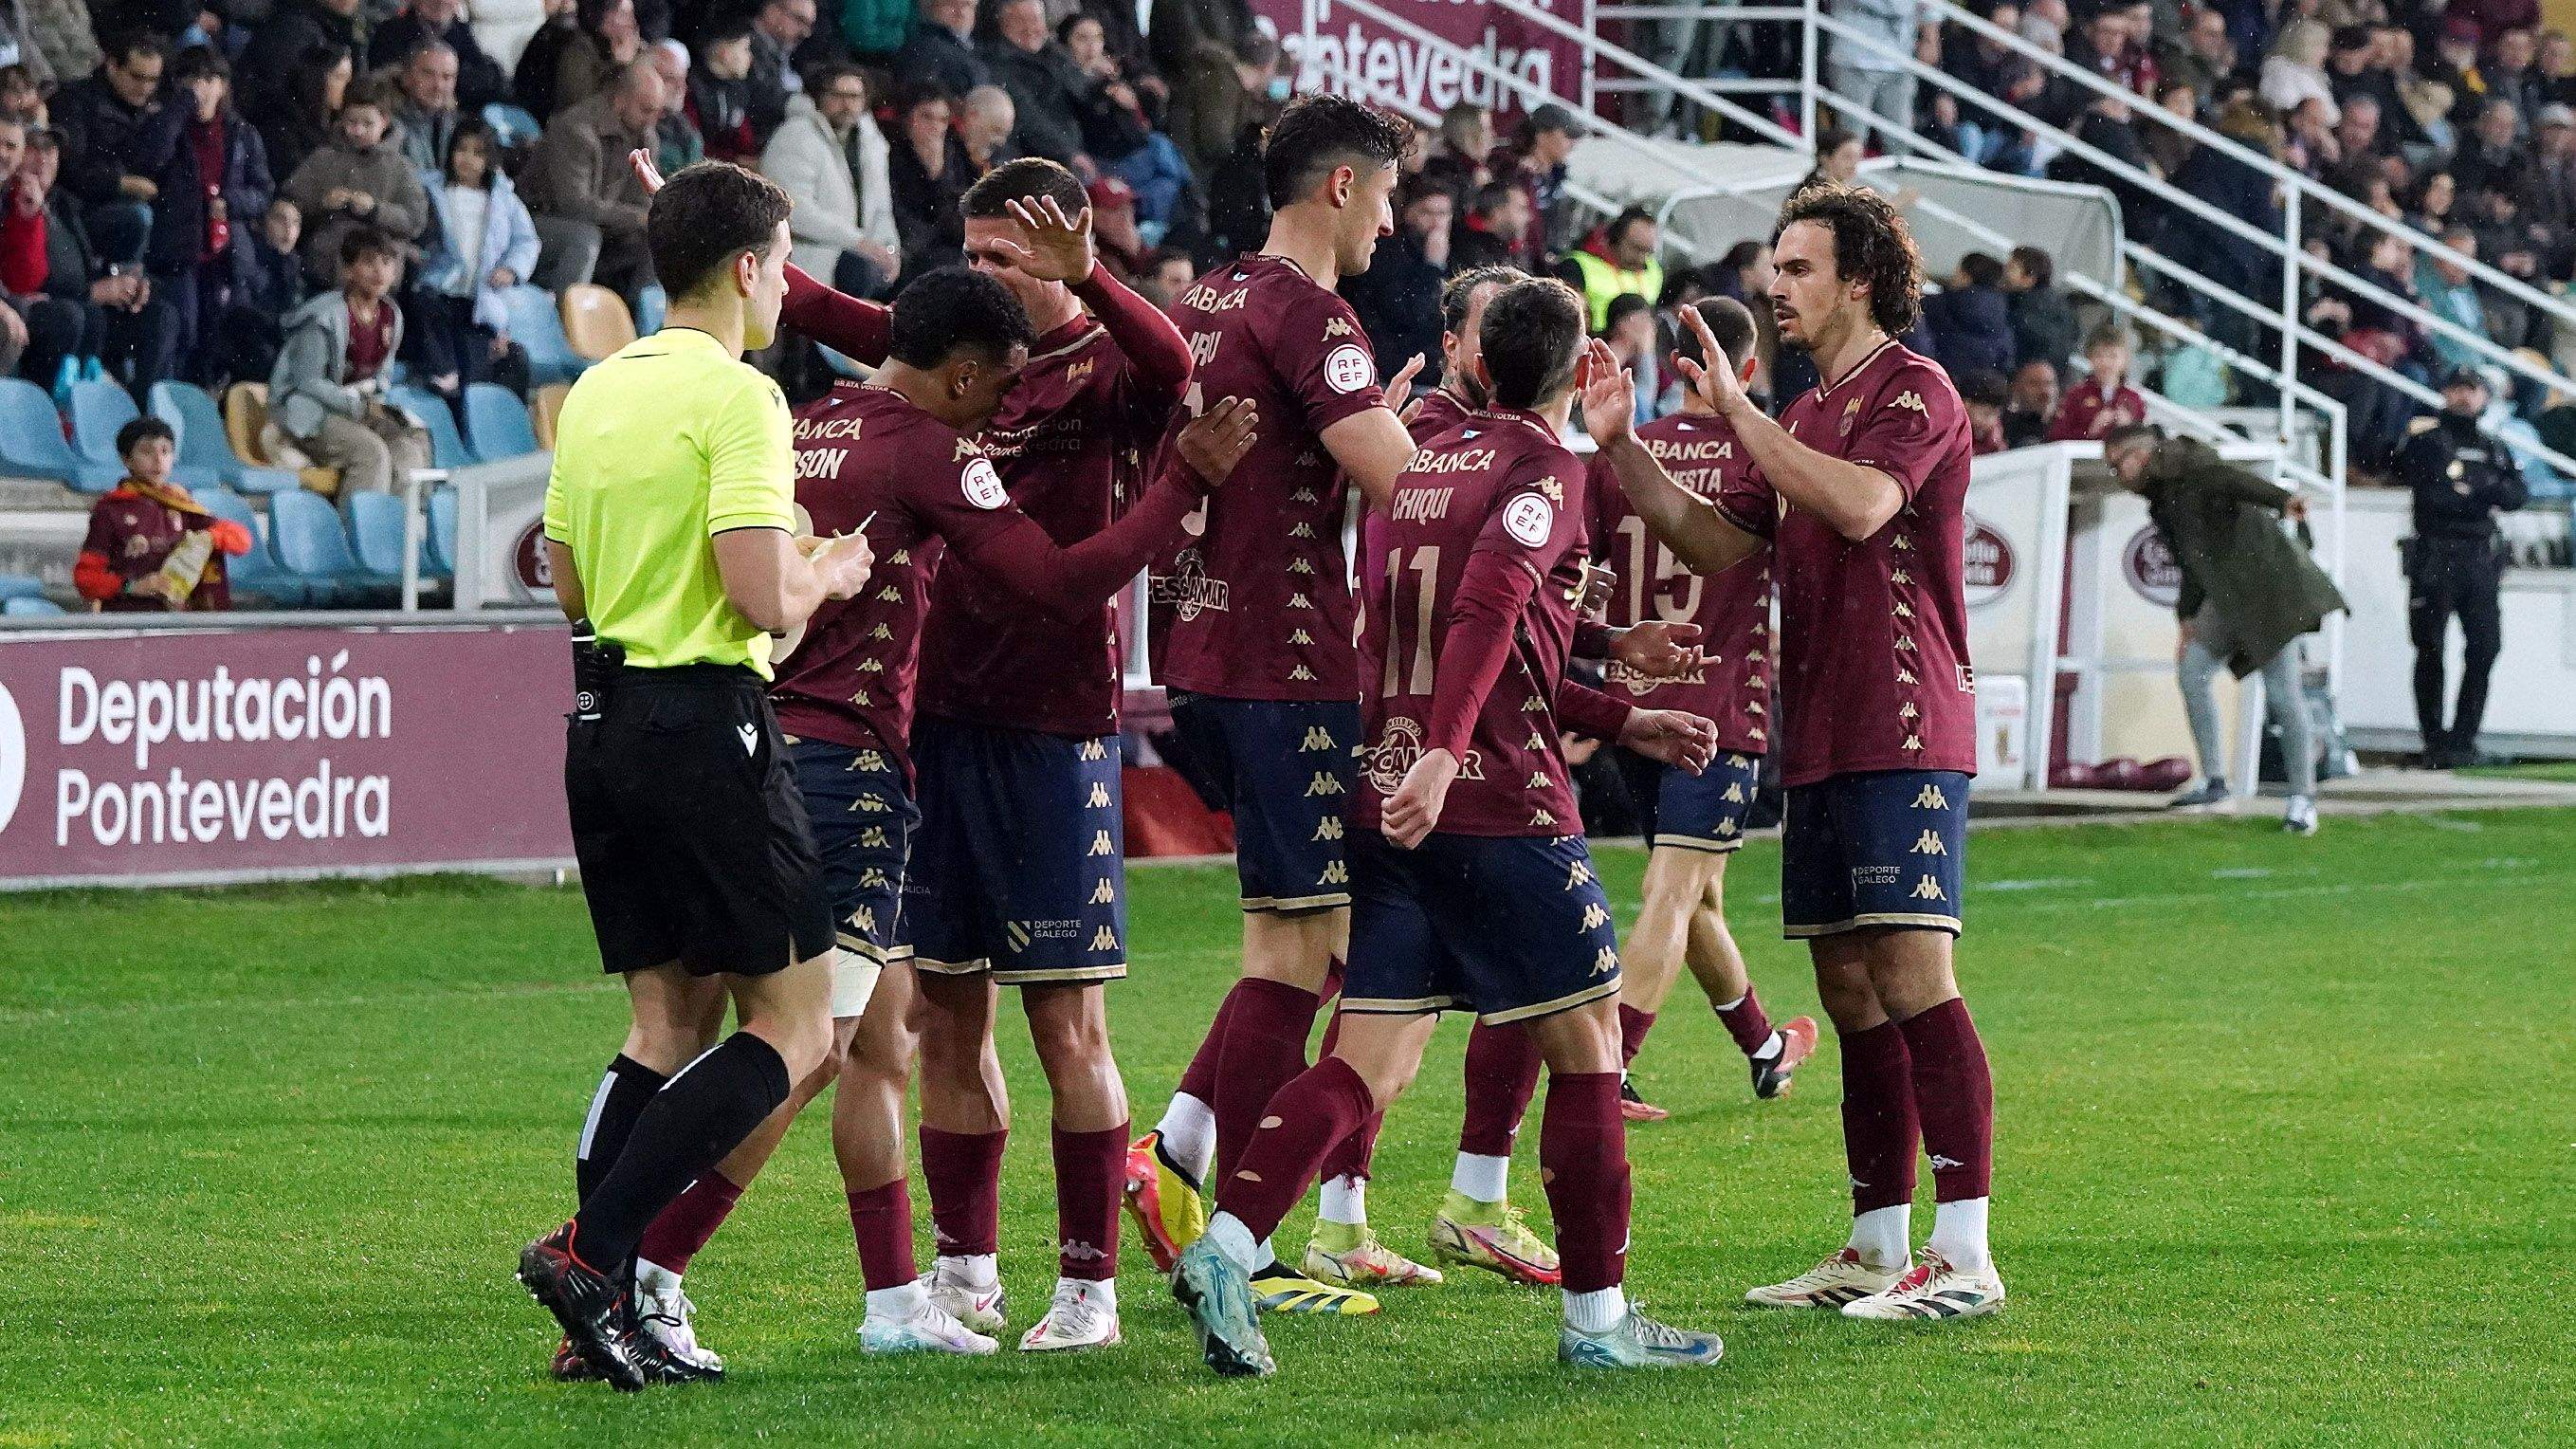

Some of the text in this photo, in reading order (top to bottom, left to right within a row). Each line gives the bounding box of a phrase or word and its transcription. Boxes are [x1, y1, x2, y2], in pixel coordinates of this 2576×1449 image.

[1256, 16, 1553, 114] ontevedra
[1492, 412, 1521, 421] VOLTAR
[1402, 449, 1496, 474] ABANCA
[1645, 439, 1733, 461] BANCA
[1393, 486, 1454, 526] CHIQUI
[1617, 515, 1705, 626] 15
[1382, 545, 1441, 699] 11
[58, 649, 392, 770] Deputación
[57, 759, 391, 846] Pontevedra
[1857, 866, 1901, 875] DEPORTE
[1857, 875, 1896, 885] GALEGO
[1034, 919, 1082, 929] DEPORTE
[1034, 929, 1077, 938] GALEGO
